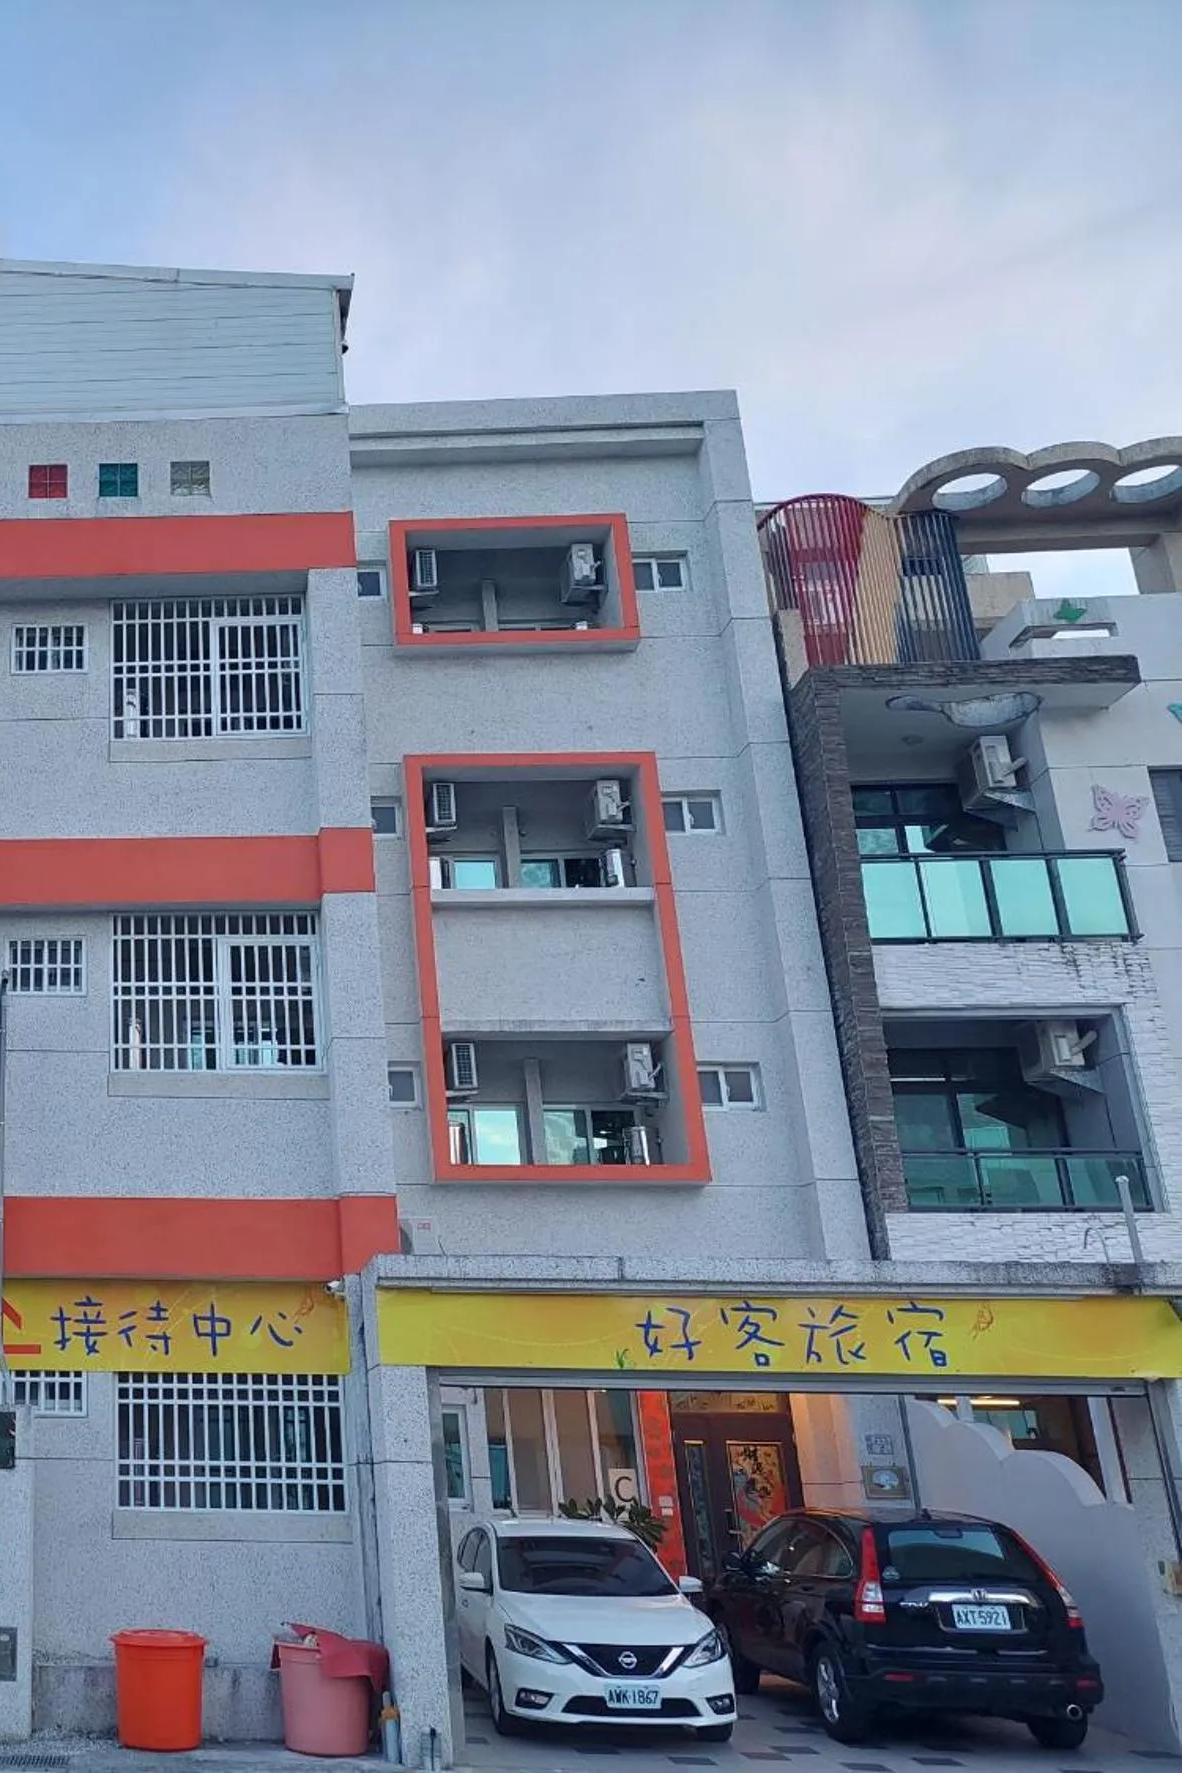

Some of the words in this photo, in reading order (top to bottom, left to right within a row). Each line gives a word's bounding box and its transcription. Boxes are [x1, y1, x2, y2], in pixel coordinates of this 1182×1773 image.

[50, 1296, 303, 1357] 接待中心
[635, 1300, 948, 1367] 好客旅宿
